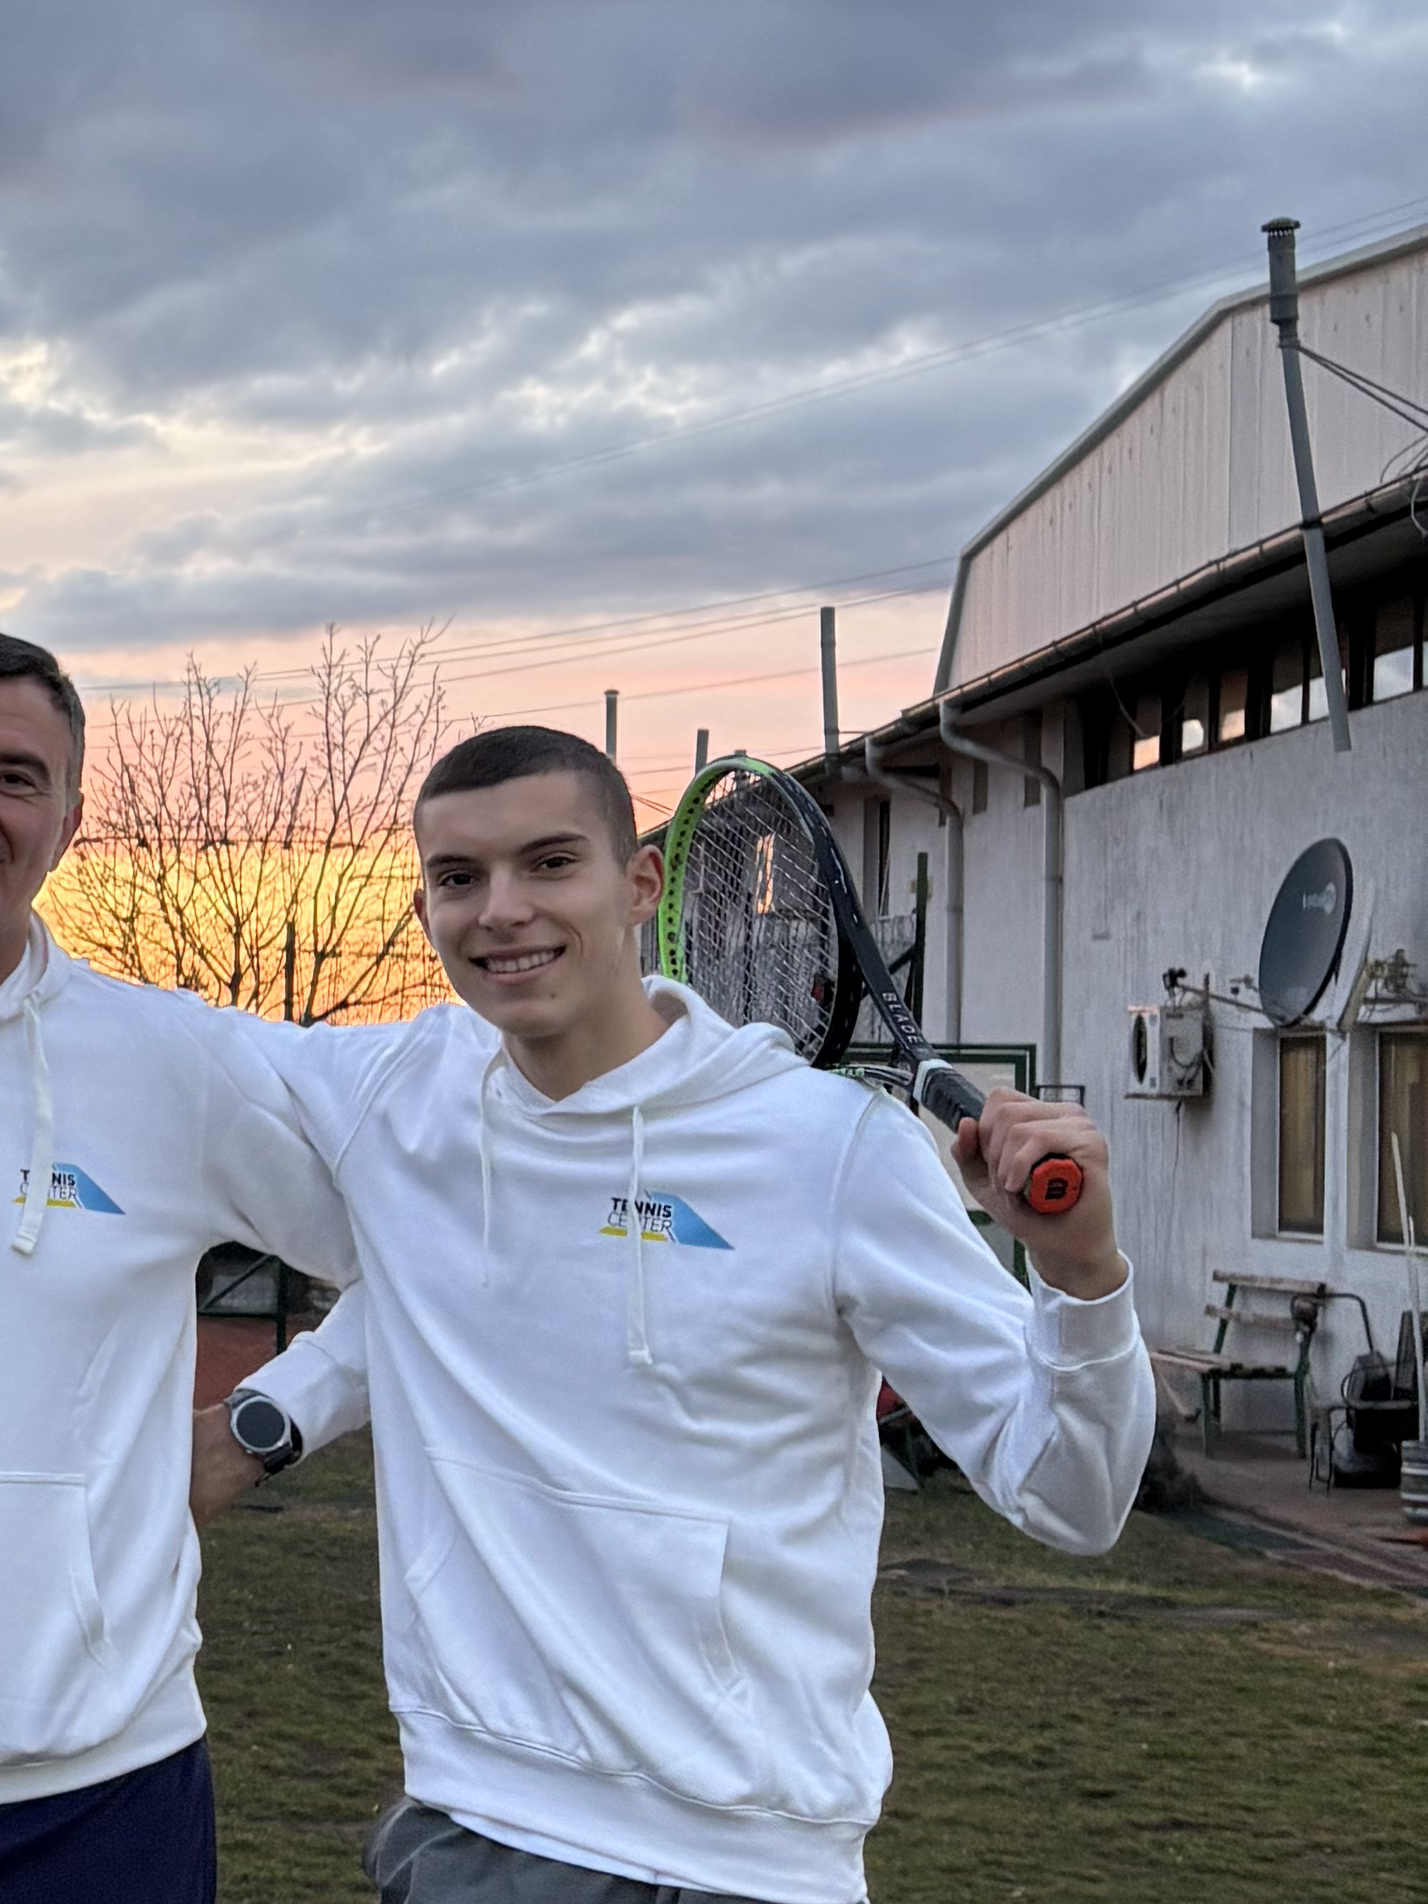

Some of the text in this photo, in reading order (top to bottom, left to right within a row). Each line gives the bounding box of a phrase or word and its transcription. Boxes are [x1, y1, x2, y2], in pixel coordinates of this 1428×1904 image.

[882, 992, 924, 1044] BLADE
[20, 1168, 76, 1187] TNIS
[20, 1182, 77, 1200] CTER
[611, 1197, 673, 1218] TENNIS
[607, 1210, 673, 1233] CETER
